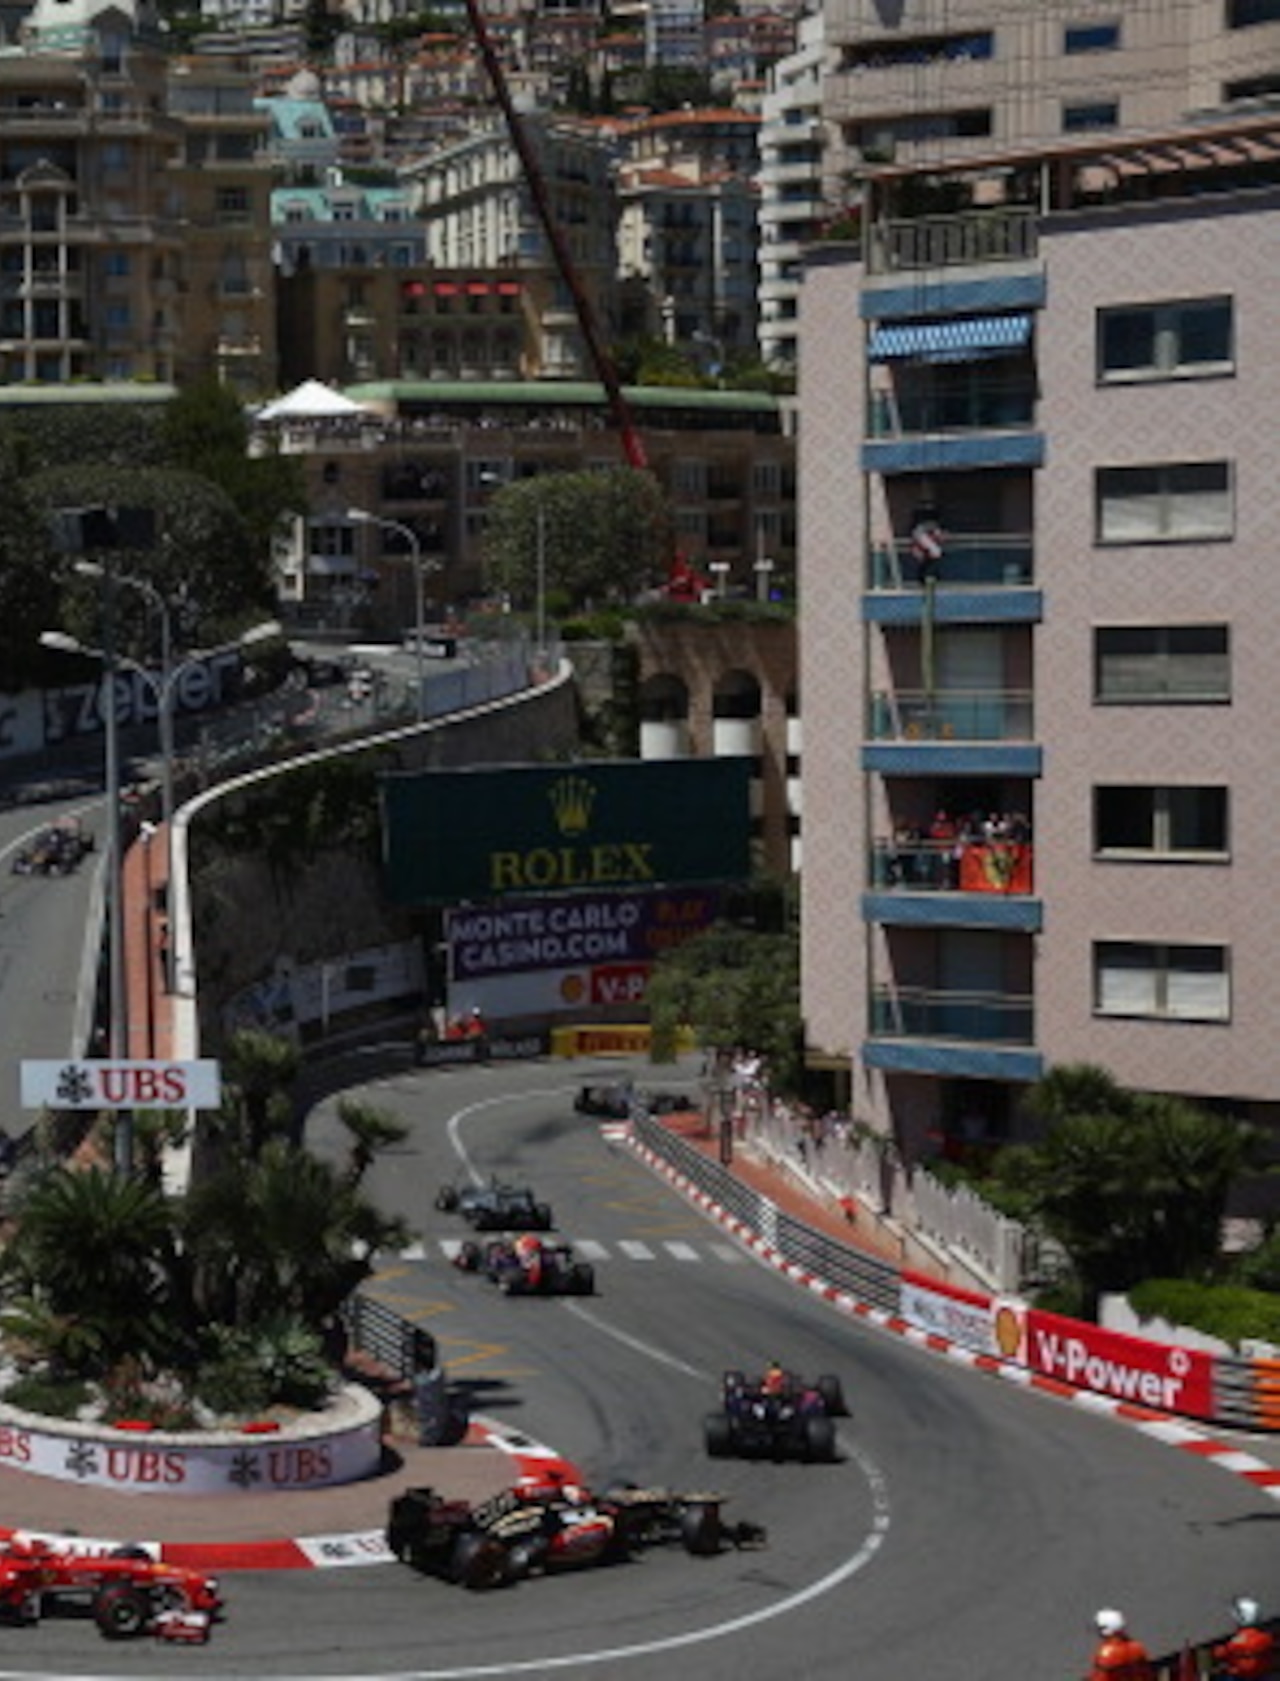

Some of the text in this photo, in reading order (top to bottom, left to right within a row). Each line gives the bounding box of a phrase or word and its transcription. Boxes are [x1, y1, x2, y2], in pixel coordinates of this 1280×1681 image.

[490, 844, 653, 889] ROLEX
[449, 903, 639, 943] MONTE CARLO
[460, 932, 627, 969] CASINO.COM
[99, 1068, 187, 1101] UBS
[1035, 1329, 1184, 1408] V-Power
[105, 1450, 186, 1482] UBS
[267, 1445, 334, 1483] UBS
